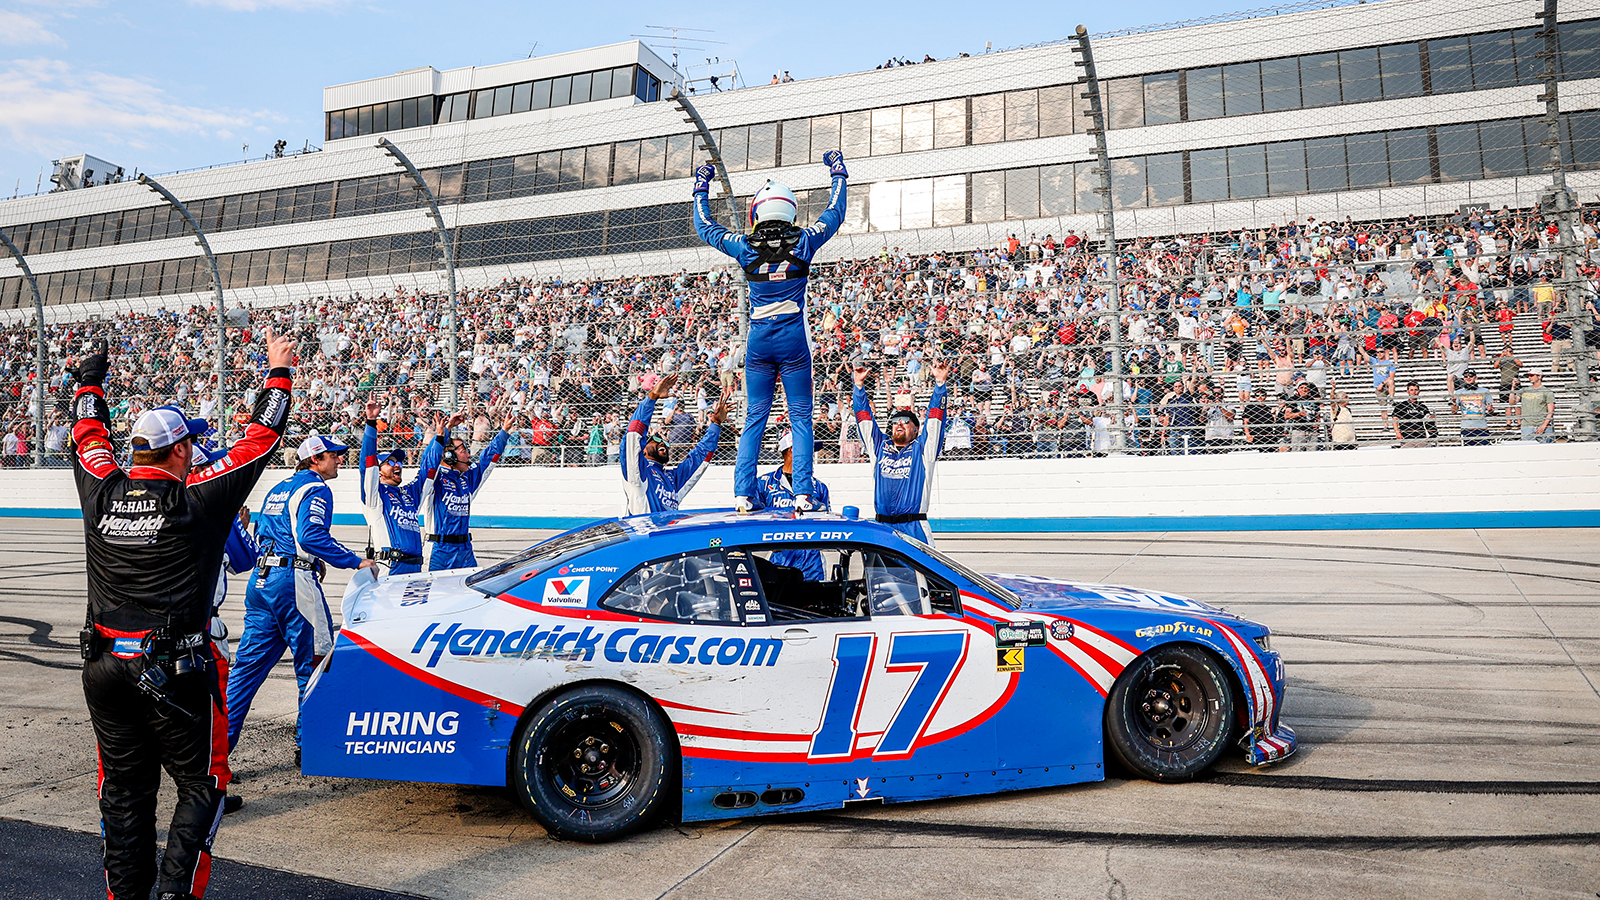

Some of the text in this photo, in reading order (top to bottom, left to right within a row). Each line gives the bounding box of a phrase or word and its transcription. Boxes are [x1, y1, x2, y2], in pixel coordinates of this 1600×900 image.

[1466, 206, 1484, 214] 104
[258, 387, 283, 426] Hendrick
[110, 500, 157, 513] McHALE
[97, 514, 166, 535] Hendrick
[762, 531, 854, 541] COREY DAY
[807, 629, 971, 765] 17
[346, 711, 460, 736] HIRING
[344, 740, 457, 755] TECHNICIANS
